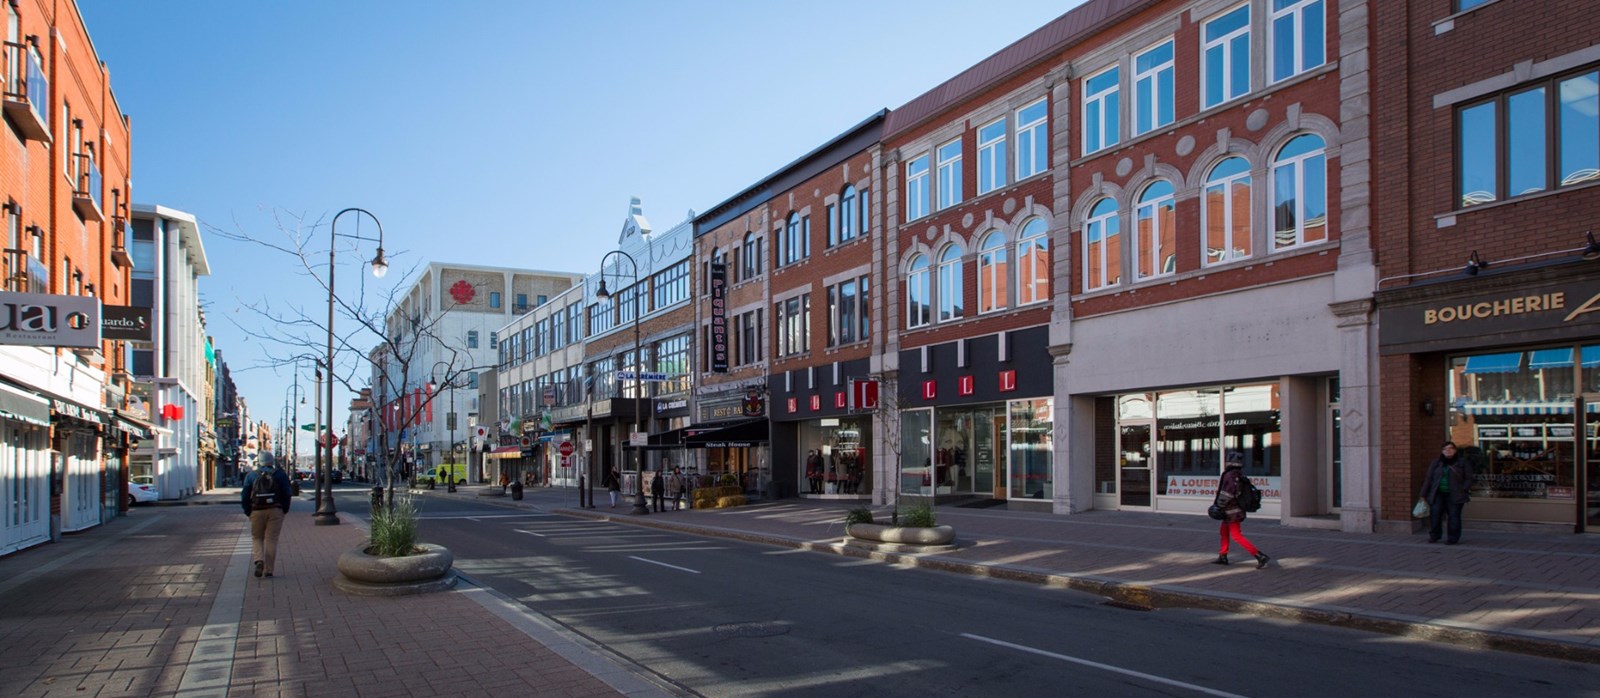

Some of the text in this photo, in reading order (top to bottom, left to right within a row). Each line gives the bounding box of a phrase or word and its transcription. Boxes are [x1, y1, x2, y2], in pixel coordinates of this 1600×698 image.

[1424, 291, 1565, 325] BOUCHERIE
[6, 332, 56, 340] Restaurant
[963, 377, 973, 394] L
[1004, 371, 1015, 390] L
[862, 382, 876, 409] L
[926, 381, 935, 399] L
[1169, 476, 1177, 487] À
[1181, 478, 1218, 487] LOUER
